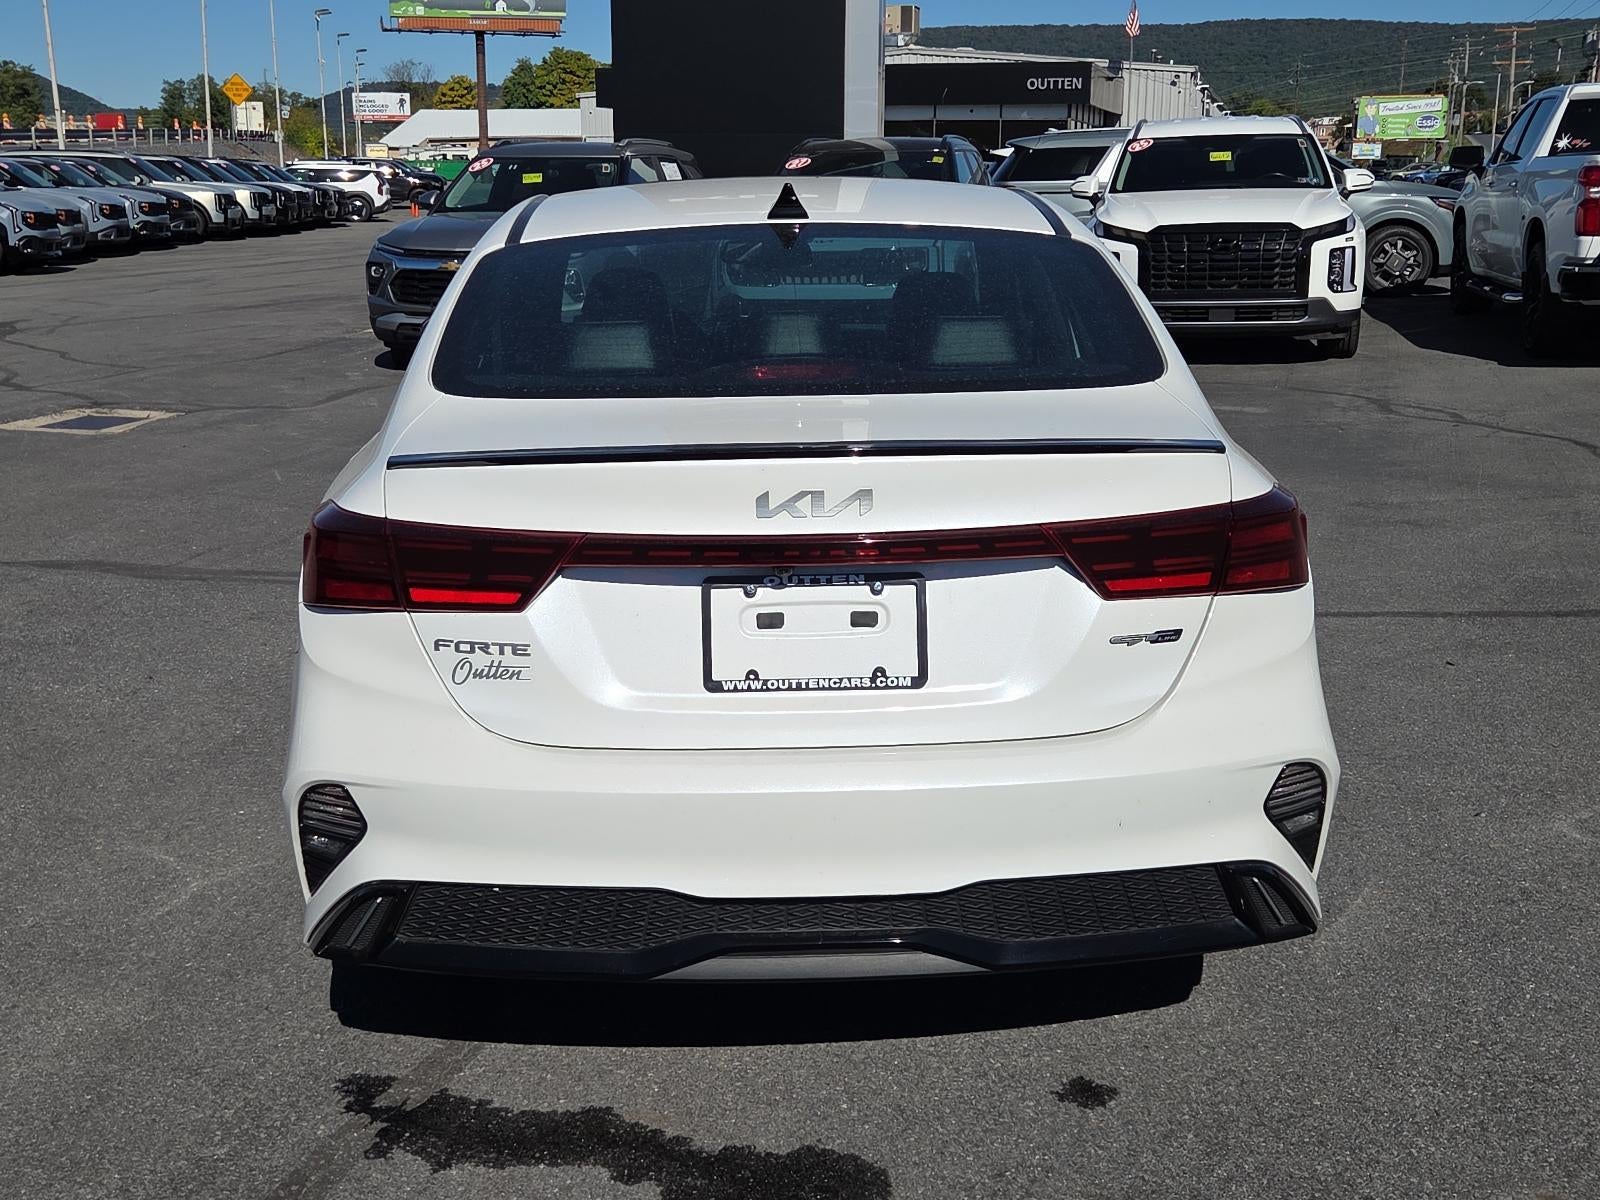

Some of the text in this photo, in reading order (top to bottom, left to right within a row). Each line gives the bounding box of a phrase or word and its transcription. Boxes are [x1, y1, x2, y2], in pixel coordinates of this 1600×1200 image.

[1027, 77, 1082, 90] OUTTEN
[763, 574, 865, 586] OUTTEN
[434, 638, 531, 657] FORTE
[452, 657, 531, 686] Outten
[722, 677, 912, 690] WWW.OUTTENCARS.COM
